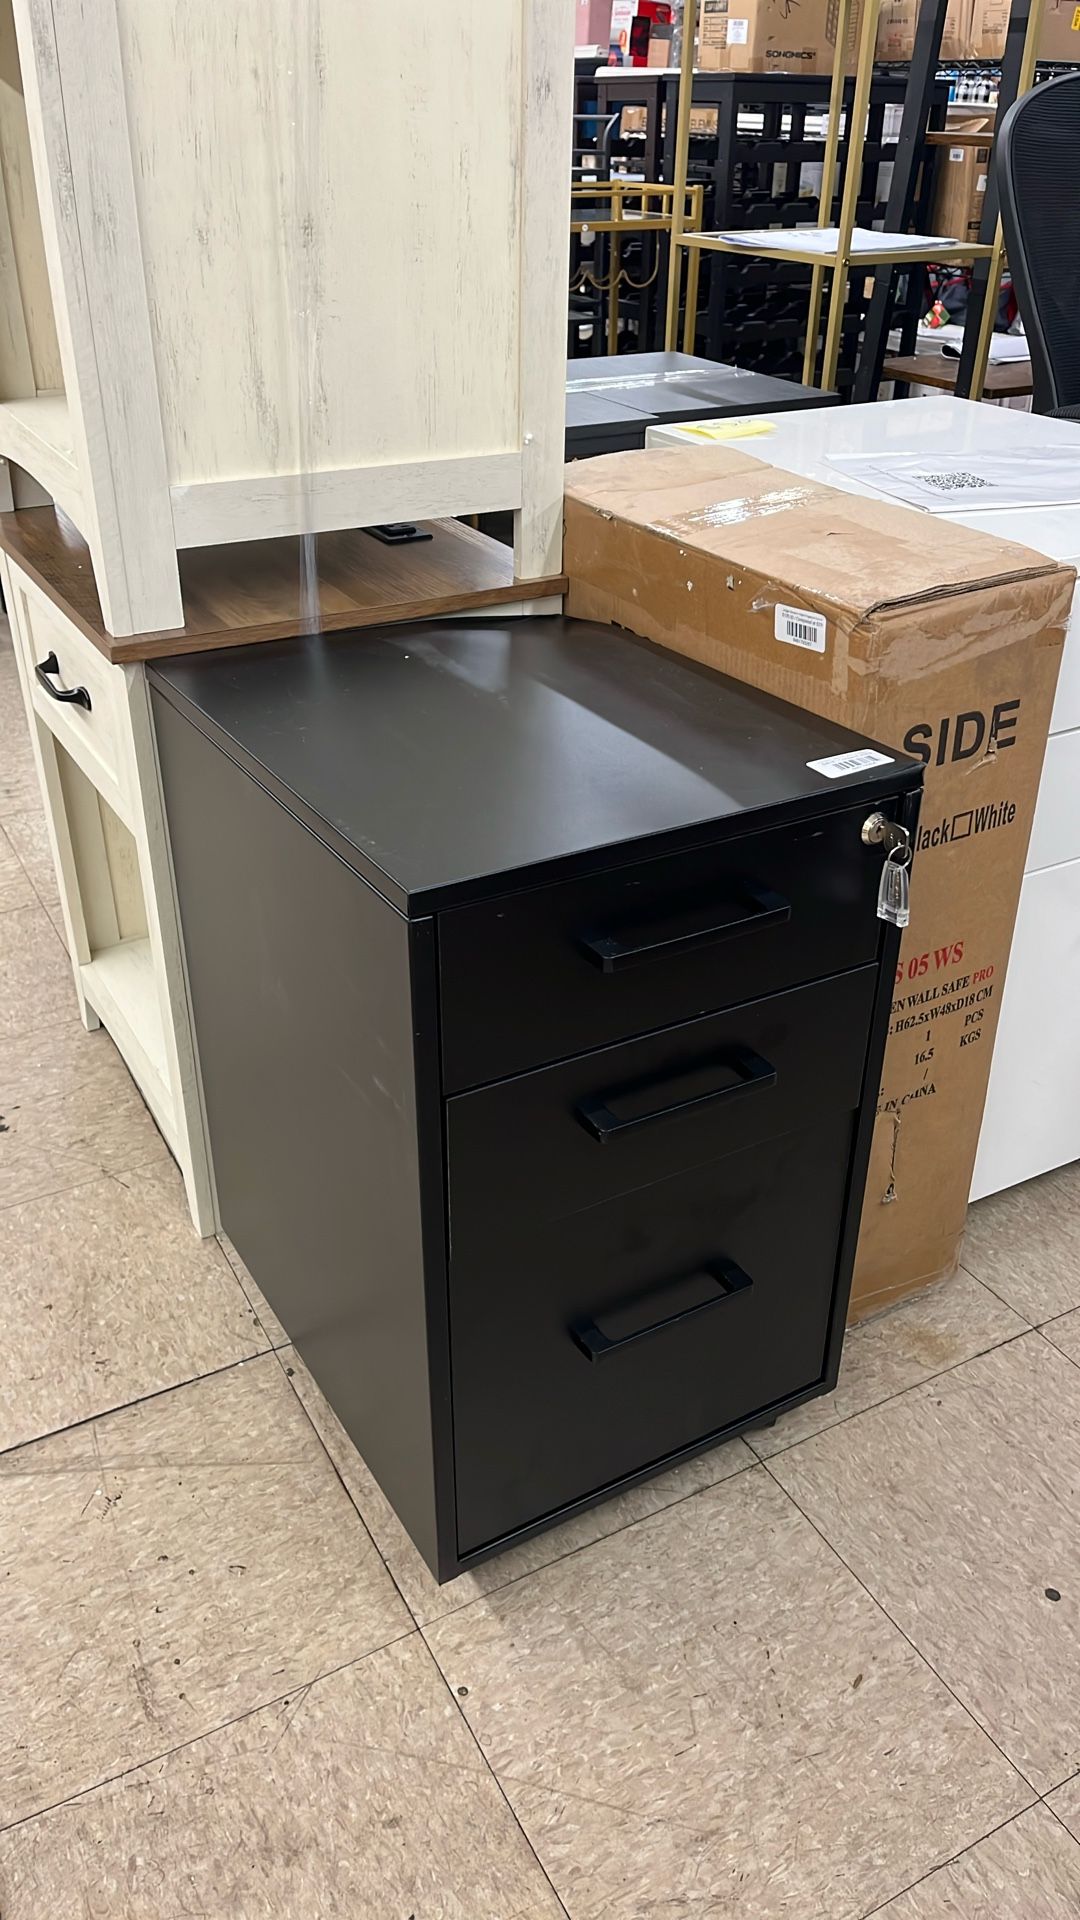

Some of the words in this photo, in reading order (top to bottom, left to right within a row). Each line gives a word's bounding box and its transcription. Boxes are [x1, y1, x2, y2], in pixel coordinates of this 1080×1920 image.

[903, 699, 1021, 767] SIDE
[916, 818, 950, 851] lack
[974, 801, 1016, 834] White
[908, 953, 929, 980] 05
[934, 941, 964, 970] WS
[907, 986, 940, 1008] WALL
[941, 975, 970, 995] SAFE
[972, 965, 994, 985] PRO
[976, 985, 994, 1003] CM
[925, 1030, 931, 1042] 1
[964, 1008, 984, 1027] PCS
[914, 1047, 934, 1065] 16.5
[959, 1028, 982, 1048] KGS
